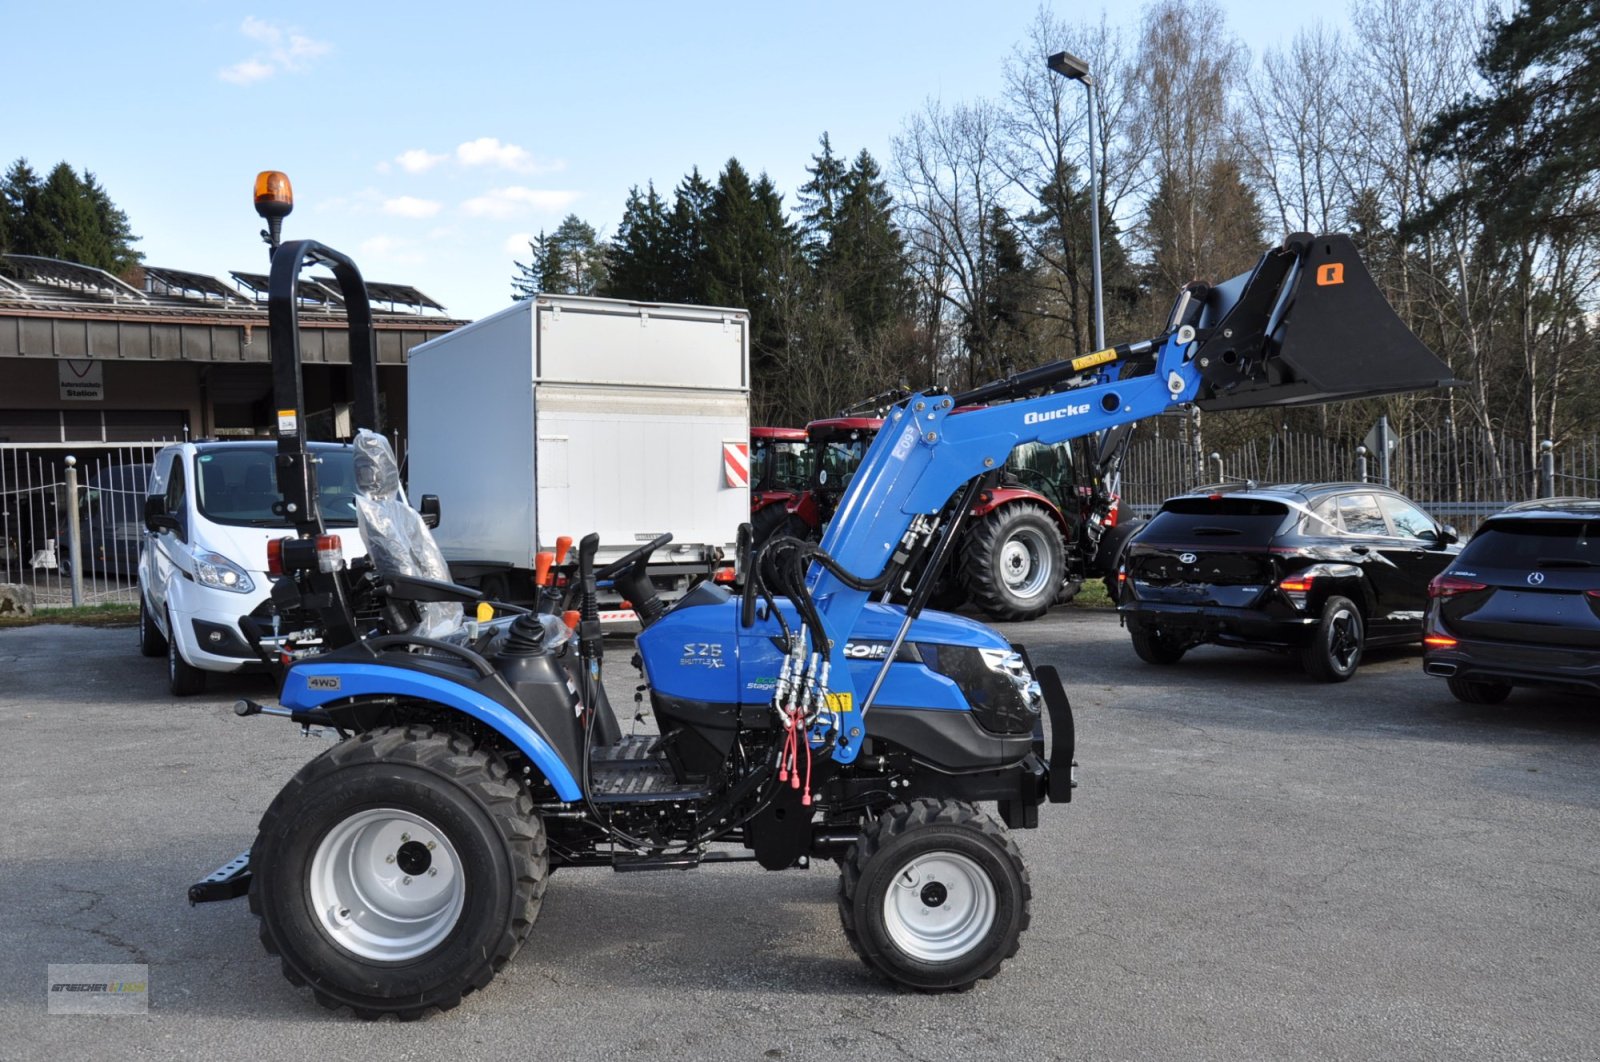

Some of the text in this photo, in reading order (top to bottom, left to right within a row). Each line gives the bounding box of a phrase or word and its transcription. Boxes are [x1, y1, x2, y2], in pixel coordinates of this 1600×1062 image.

[1024, 404, 1091, 425] Quicke
[310, 678, 337, 687] 4WD
[746, 682, 776, 691] Stage
